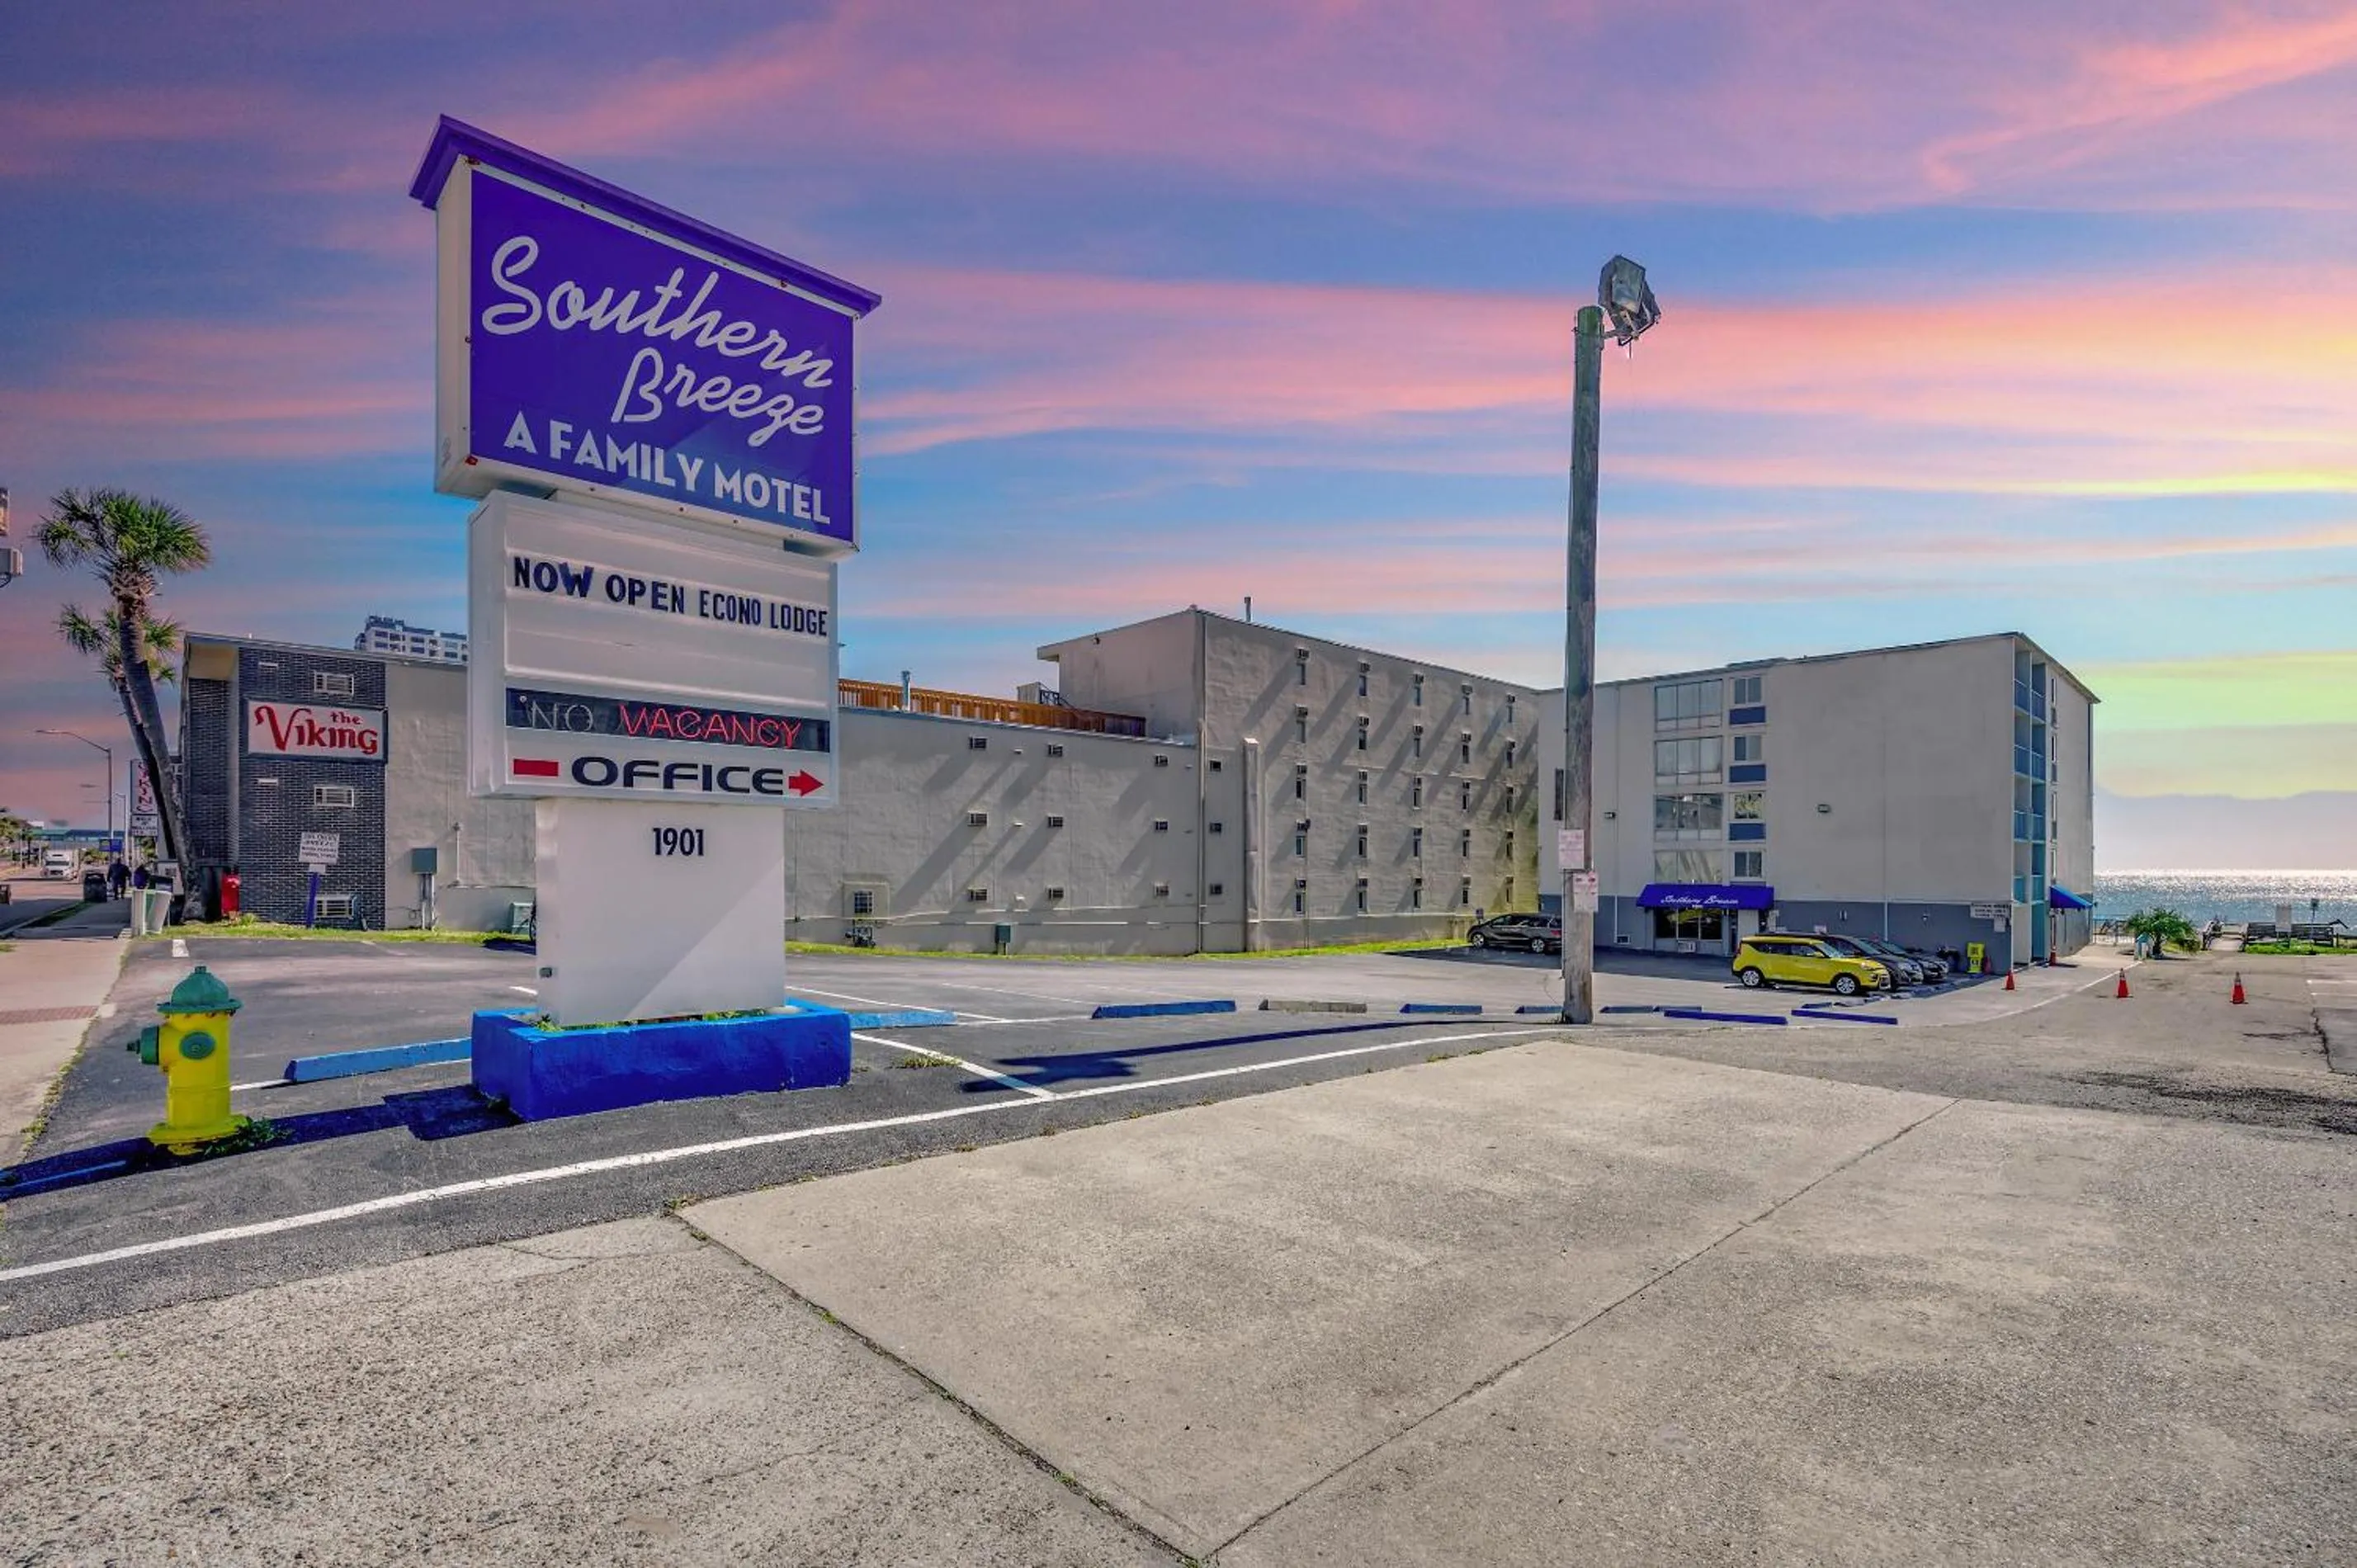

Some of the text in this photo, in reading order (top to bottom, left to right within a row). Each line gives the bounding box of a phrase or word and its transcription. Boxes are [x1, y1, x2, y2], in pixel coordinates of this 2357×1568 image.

[482, 235, 834, 388] Southern
[611, 347, 824, 446] Breeze
[503, 410, 831, 525] A FAMILY MOTEL
[514, 556, 828, 636] NOW OPEN ECONO LODGE
[254, 706, 378, 754] Viking
[331, 711, 361, 725] the
[530, 700, 802, 748] NO VACANCY
[571, 756, 783, 796] OFFICE
[653, 827, 704, 857] 1901
